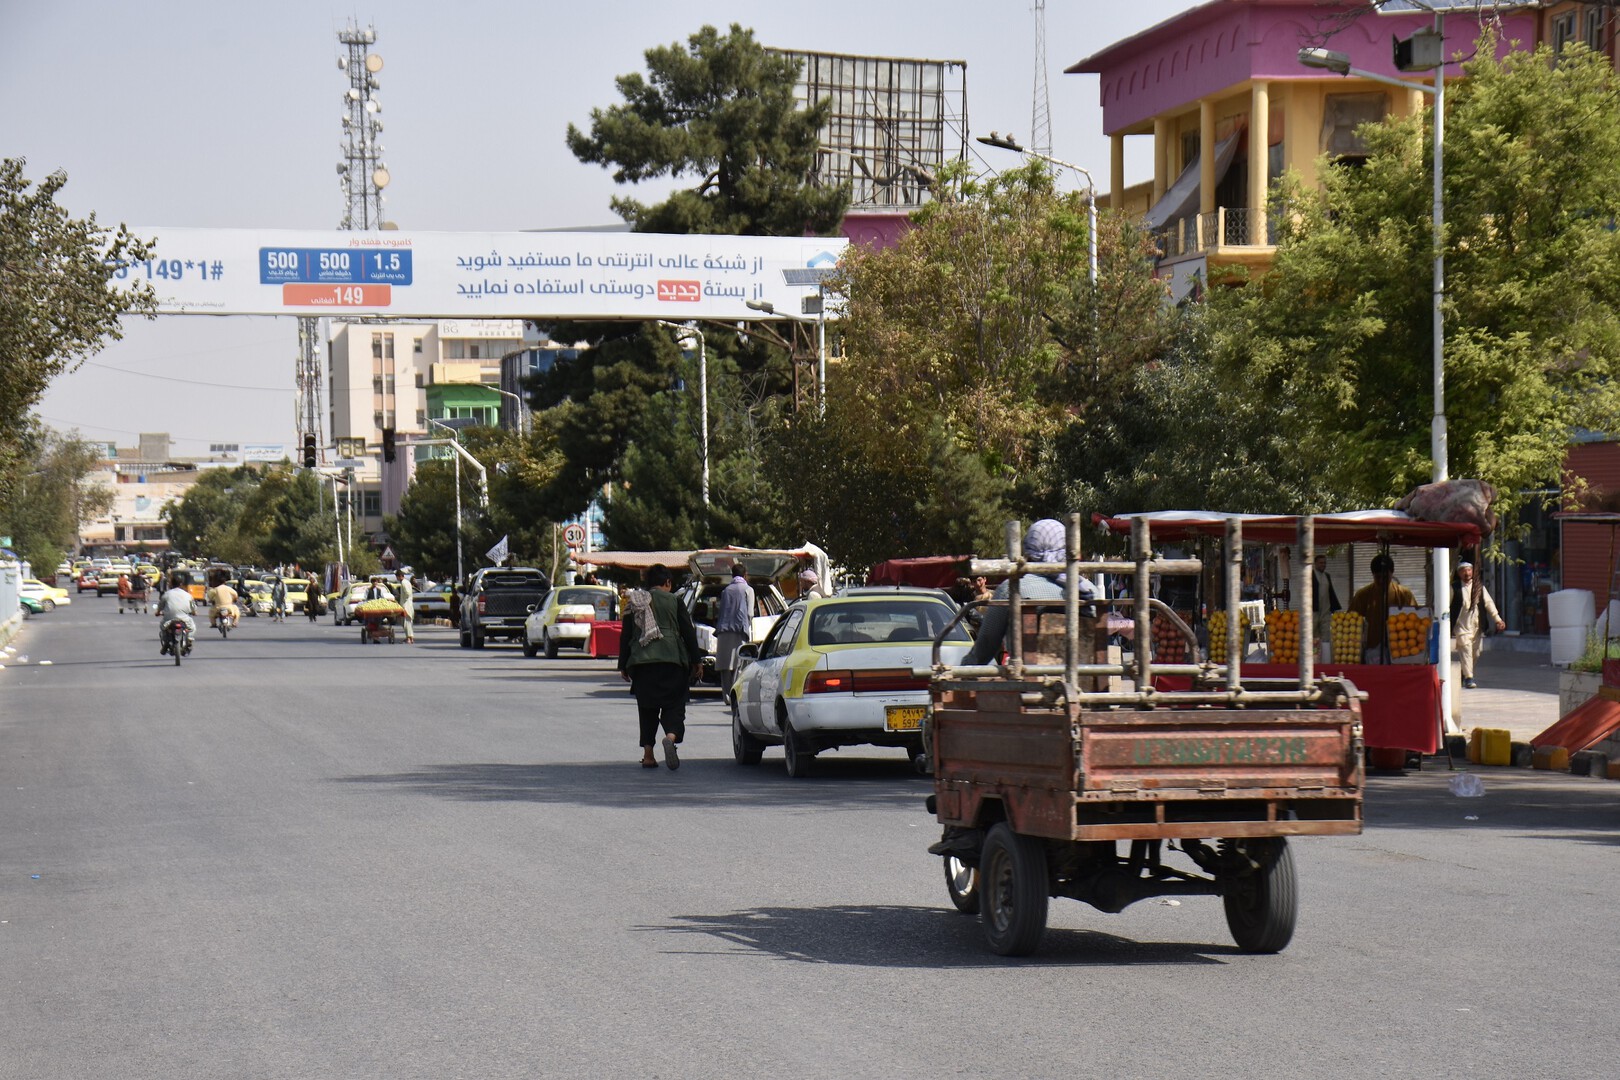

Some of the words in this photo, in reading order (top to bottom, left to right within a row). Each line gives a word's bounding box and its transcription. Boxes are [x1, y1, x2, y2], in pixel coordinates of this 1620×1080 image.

[267, 252, 298, 269] 500
[320, 252, 350, 270] 500
[373, 253, 401, 271] 1.5
[456, 249, 502, 271] شوید
[507, 252, 571, 271] مستفید
[576, 252, 593, 267] ما
[597, 252, 653, 272] انترنتی
[658, 253, 699, 269] عالی
[750, 256, 763, 275] از
[334, 286, 364, 305] 149
[456, 279, 508, 299] نمایید
[513, 279, 584, 295] استفاده
[589, 279, 655, 300] دوستی
[659, 283, 699, 301] جدید
[753, 283, 763, 300] از
[567, 529, 582, 541] 30
